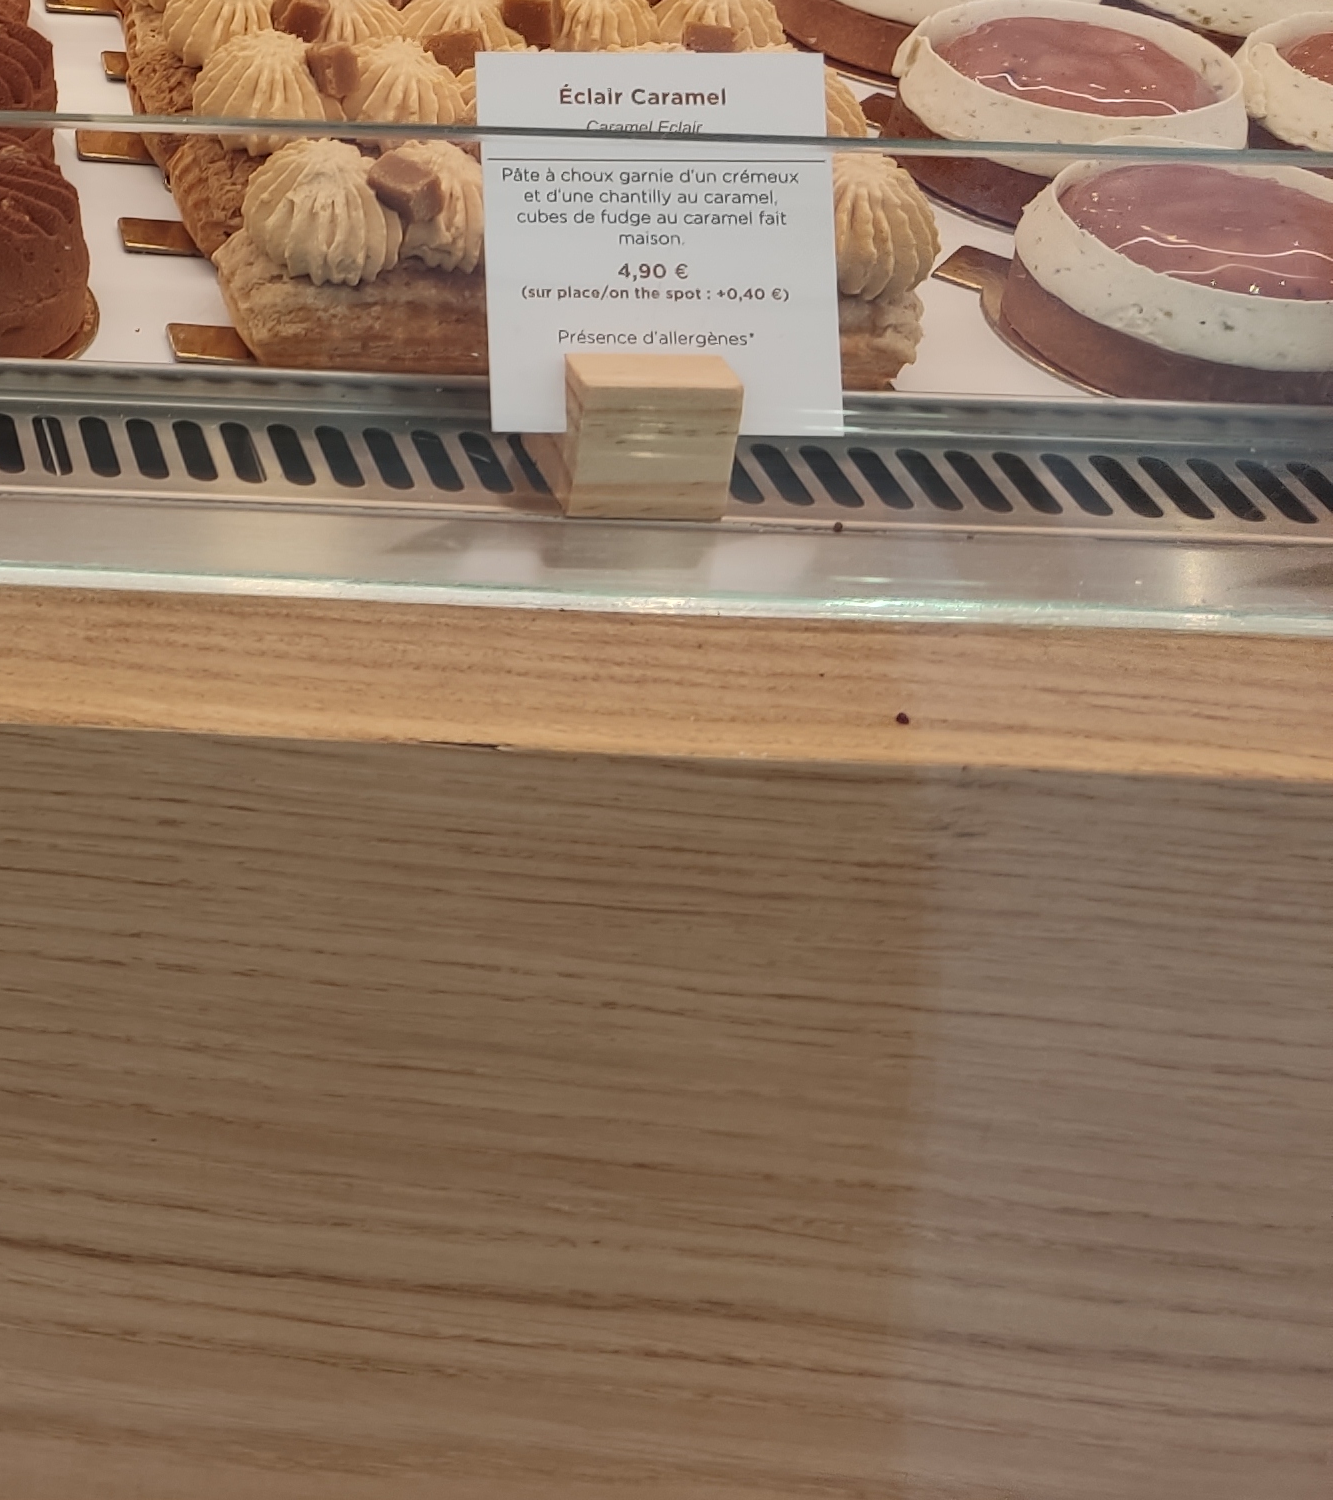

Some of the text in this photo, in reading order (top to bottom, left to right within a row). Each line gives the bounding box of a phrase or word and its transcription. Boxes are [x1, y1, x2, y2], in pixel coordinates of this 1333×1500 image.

[560, 84, 726, 106] Éclair Caramel
[587, 119, 703, 134] Caramel Eclair
[502, 167, 799, 186] Pâte à choux garnie d'un crémeux
[524, 188, 778, 207] et d'une chantilly au caramel,
[517, 210, 787, 228] cubes de fudge au caramel fait
[619, 231, 685, 246] maison.
[618, 263, 688, 281] 4,90 €
[522, 286, 551, 300] (sur
[557, 286, 630, 302] place/on
[635, 288, 659, 300] the
[666, 289, 701, 304] spot
[717, 288, 765, 303] +0,40
[771, 289, 790, 302] €)
[558, 330, 637, 345] Présence
